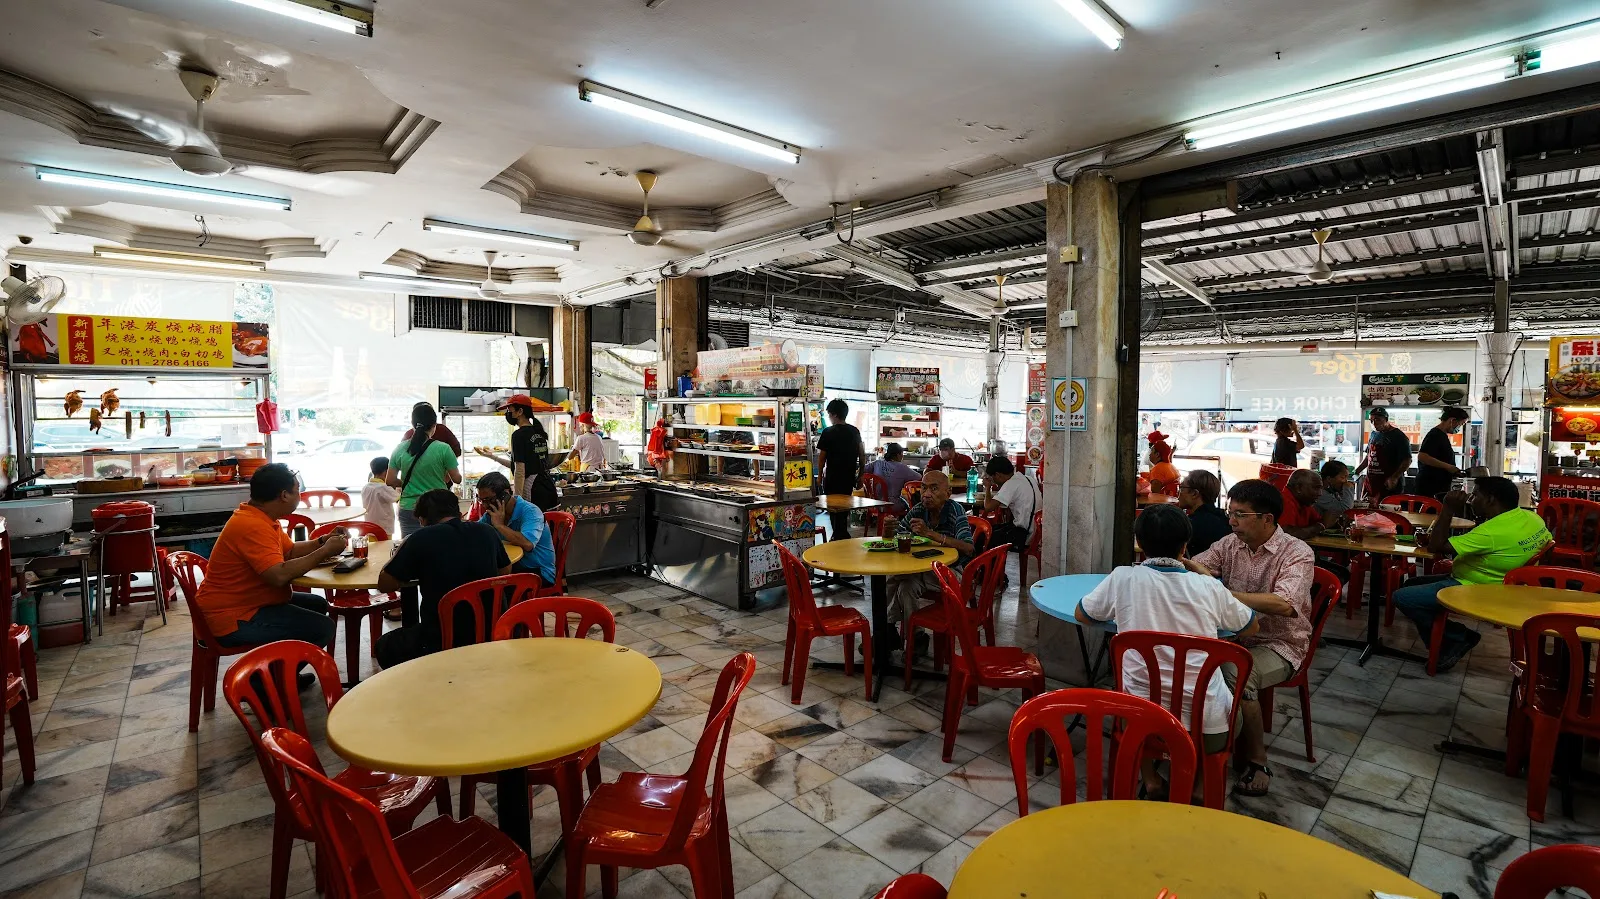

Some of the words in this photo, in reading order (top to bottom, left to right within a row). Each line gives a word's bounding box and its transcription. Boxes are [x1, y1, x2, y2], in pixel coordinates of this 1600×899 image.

[73, 318, 90, 363] 新鲜炭烧
[183, 359, 210, 367] 4166
[786, 467, 808, 483] 水果
